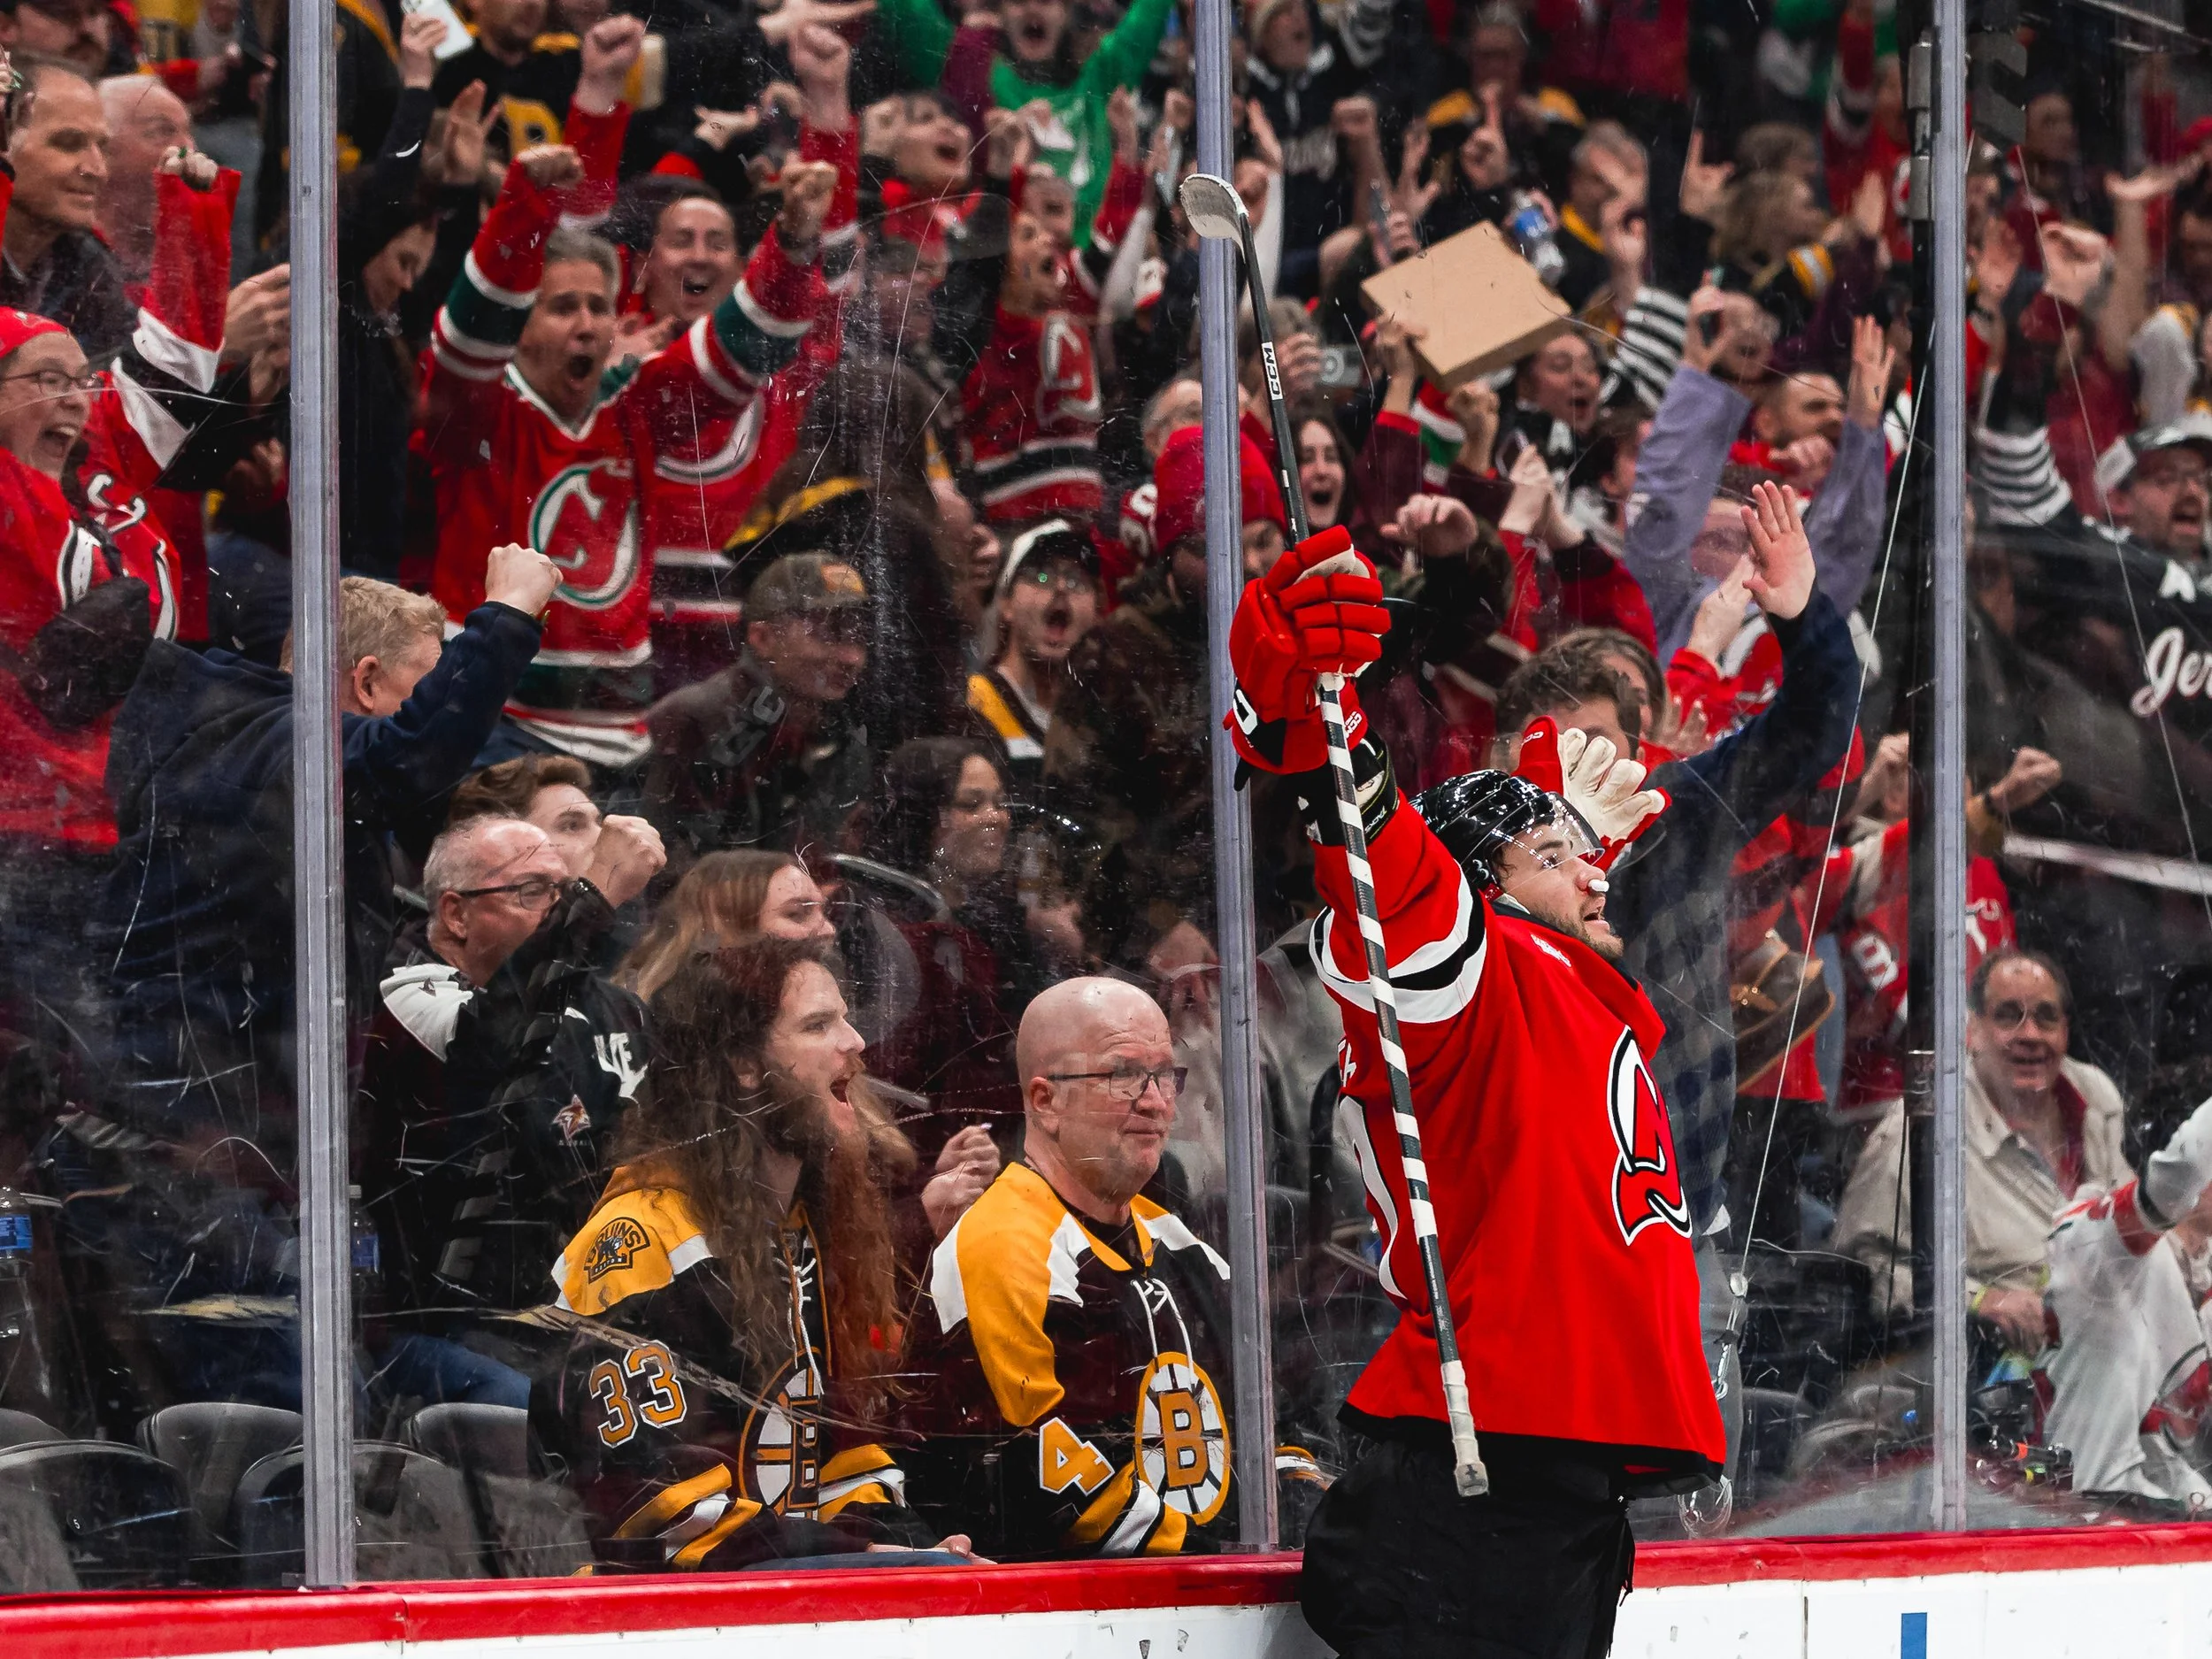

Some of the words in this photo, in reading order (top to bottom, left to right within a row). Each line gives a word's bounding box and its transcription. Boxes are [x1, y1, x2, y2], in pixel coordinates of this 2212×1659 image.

[1263, 347, 1280, 395] CCM
[589, 1339, 687, 1448] 33
[1039, 1417, 1115, 1496] 4
[1157, 1387, 1212, 1488] B
[73, 1518, 81, 1529] 5
[355, 1516, 362, 1526] 6
